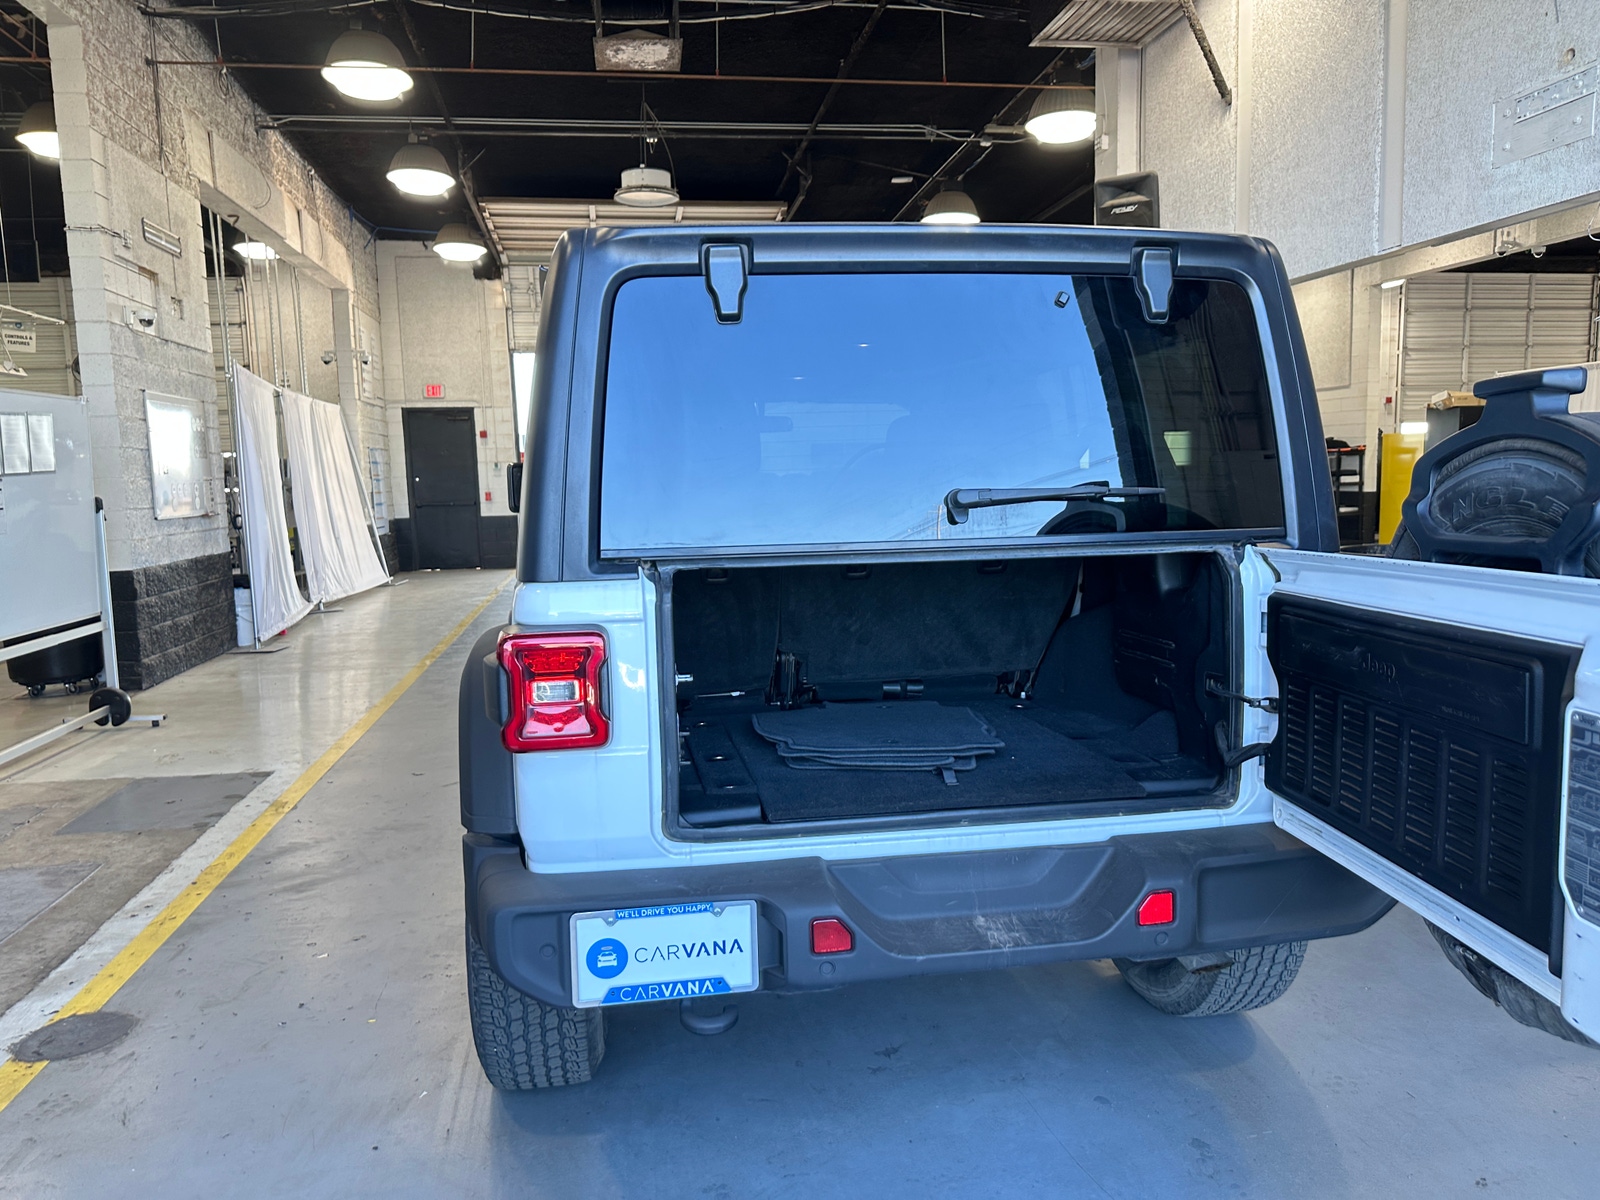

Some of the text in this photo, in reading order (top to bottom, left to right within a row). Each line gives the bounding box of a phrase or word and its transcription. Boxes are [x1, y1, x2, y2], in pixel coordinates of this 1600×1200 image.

[426, 385, 442, 397] EXIT
[617, 910, 640, 919] WE'LL
[641, 907, 665, 917] DRIVE
[667, 905, 684, 914] YOU
[634, 938, 744, 963] CARVANA
